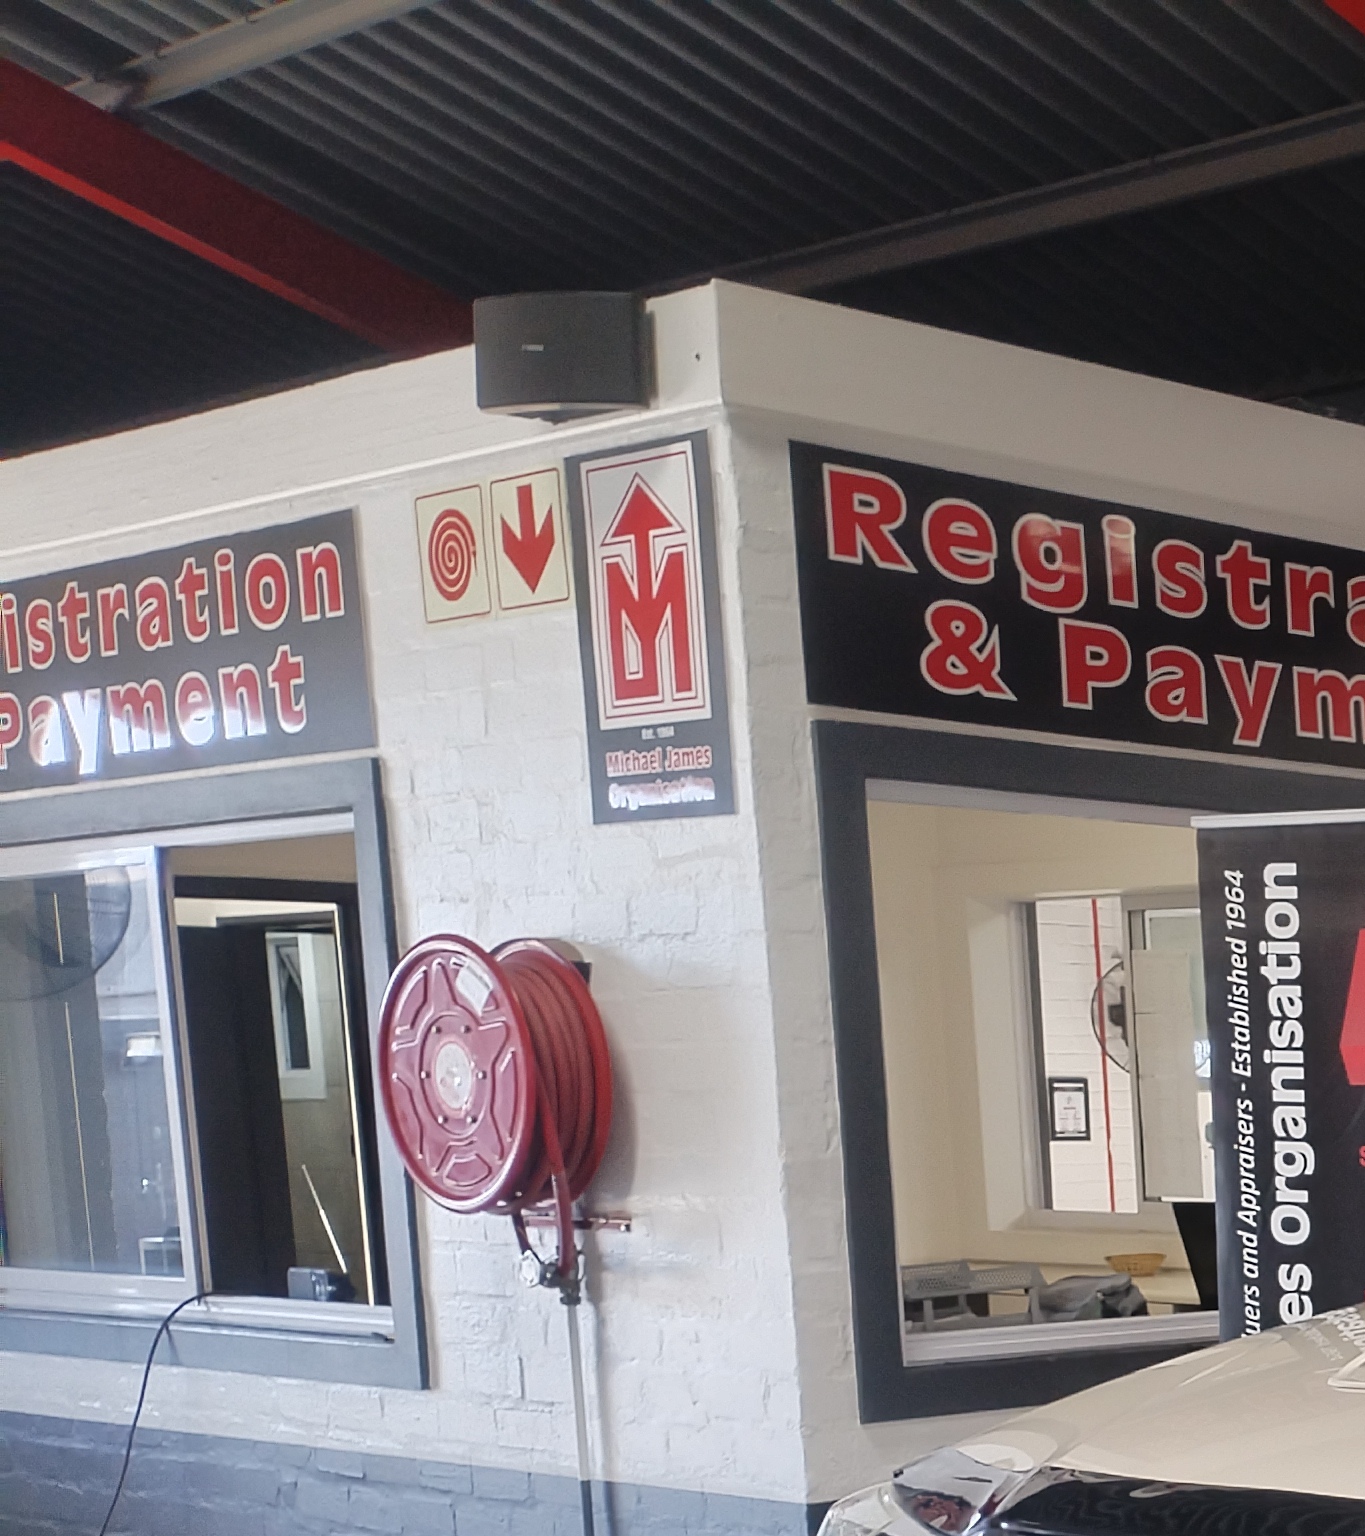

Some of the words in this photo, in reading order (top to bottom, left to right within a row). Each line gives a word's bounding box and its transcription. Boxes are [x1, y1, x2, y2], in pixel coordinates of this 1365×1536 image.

[919, 600, 1017, 702] &
[606, 747, 663, 778] Michael
[665, 745, 712, 772] James
[1224, 869, 1246, 929] 1964
[1225, 936, 1252, 1077] Established
[1233, 1098, 1261, 1226] Appraisers
[1236, 1230, 1259, 1278] and
